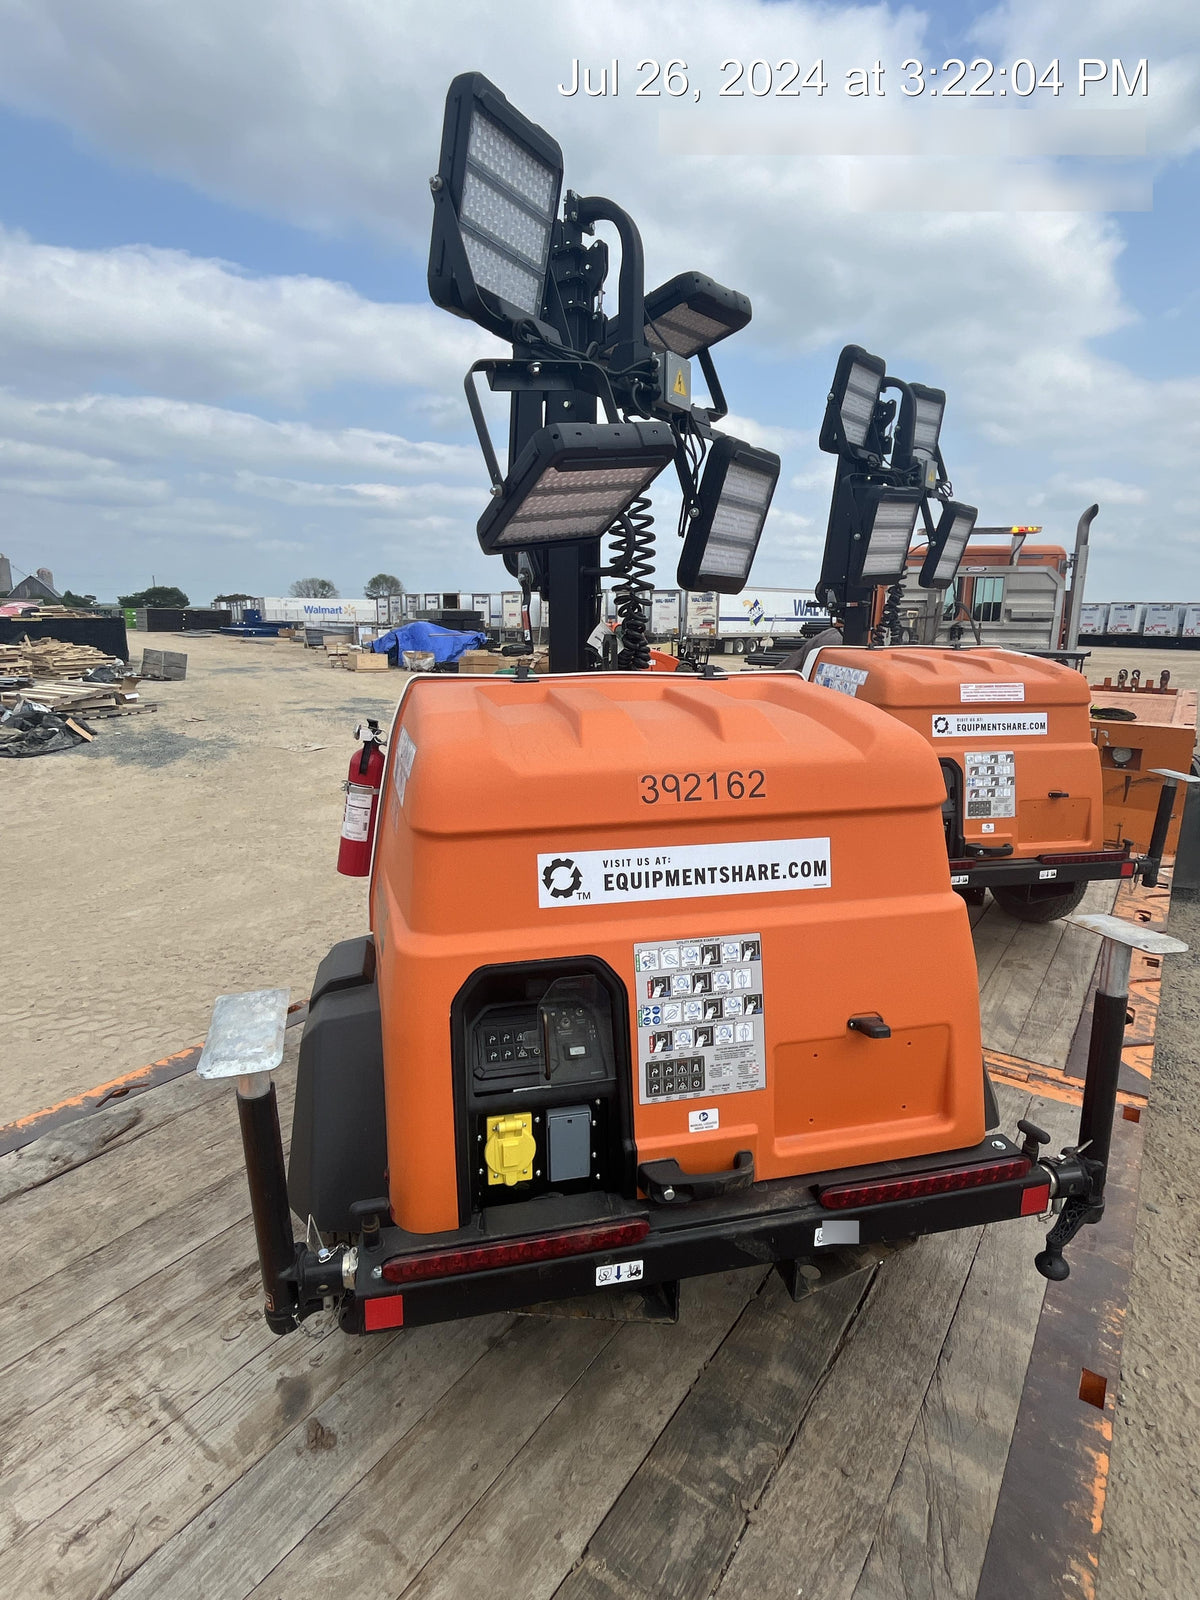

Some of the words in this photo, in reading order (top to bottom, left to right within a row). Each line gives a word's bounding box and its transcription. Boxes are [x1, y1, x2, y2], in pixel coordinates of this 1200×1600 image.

[303, 605, 343, 615] Walmart
[956, 722, 1046, 732] EQUIPMENTSHARE.COM
[640, 769, 767, 805] 392162
[602, 858, 632, 869] VISIT
[637, 857, 650, 867] US
[655, 856, 671, 866] AT:
[603, 859, 828, 892] EQUIPMENTSHARE.COM
[576, 891, 591, 901] TM
